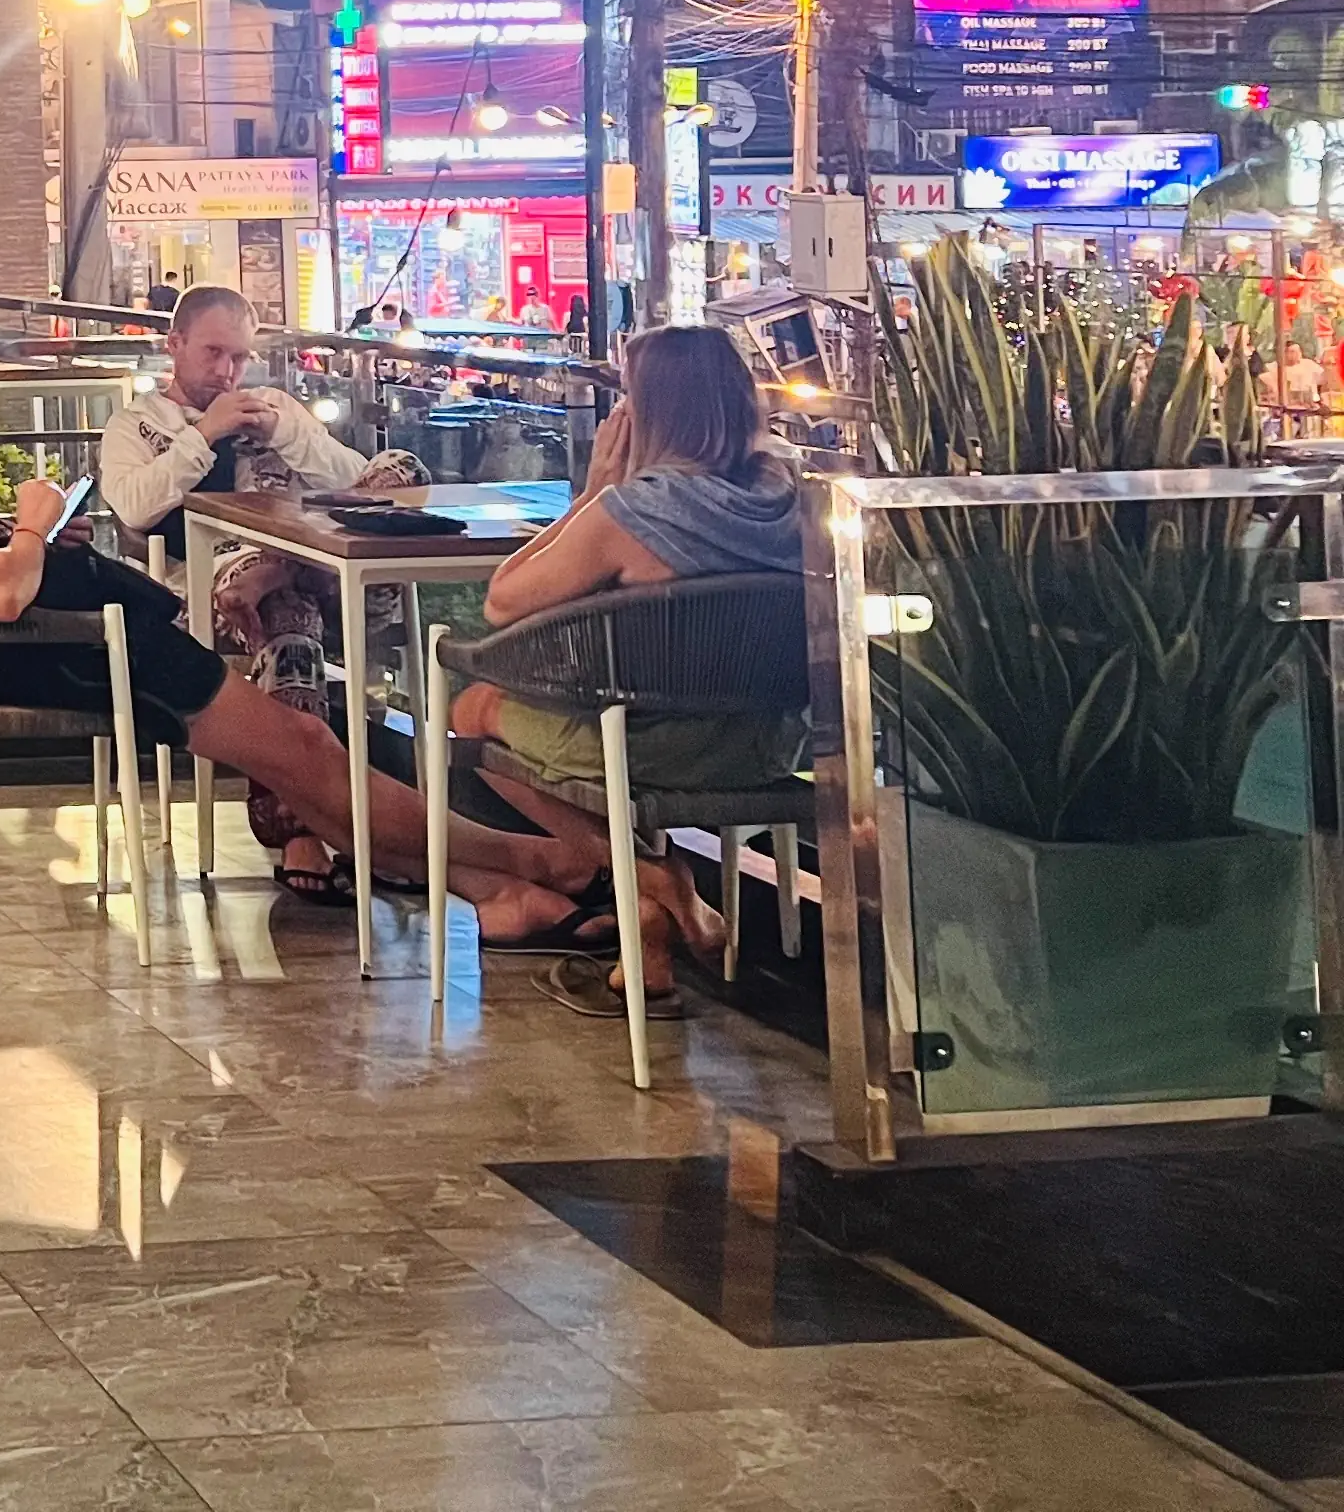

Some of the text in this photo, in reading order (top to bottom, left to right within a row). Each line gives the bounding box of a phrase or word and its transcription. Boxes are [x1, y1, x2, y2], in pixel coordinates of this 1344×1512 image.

[983, 16, 1037, 29] MASSAGE
[992, 39, 1046, 51] MASSAGE
[999, 62, 1053, 74] MASSAGE
[1066, 149, 1181, 171] MASSAGE
[198, 169, 310, 182] PATTAYA PARK
[108, 199, 188, 215] Массаж
